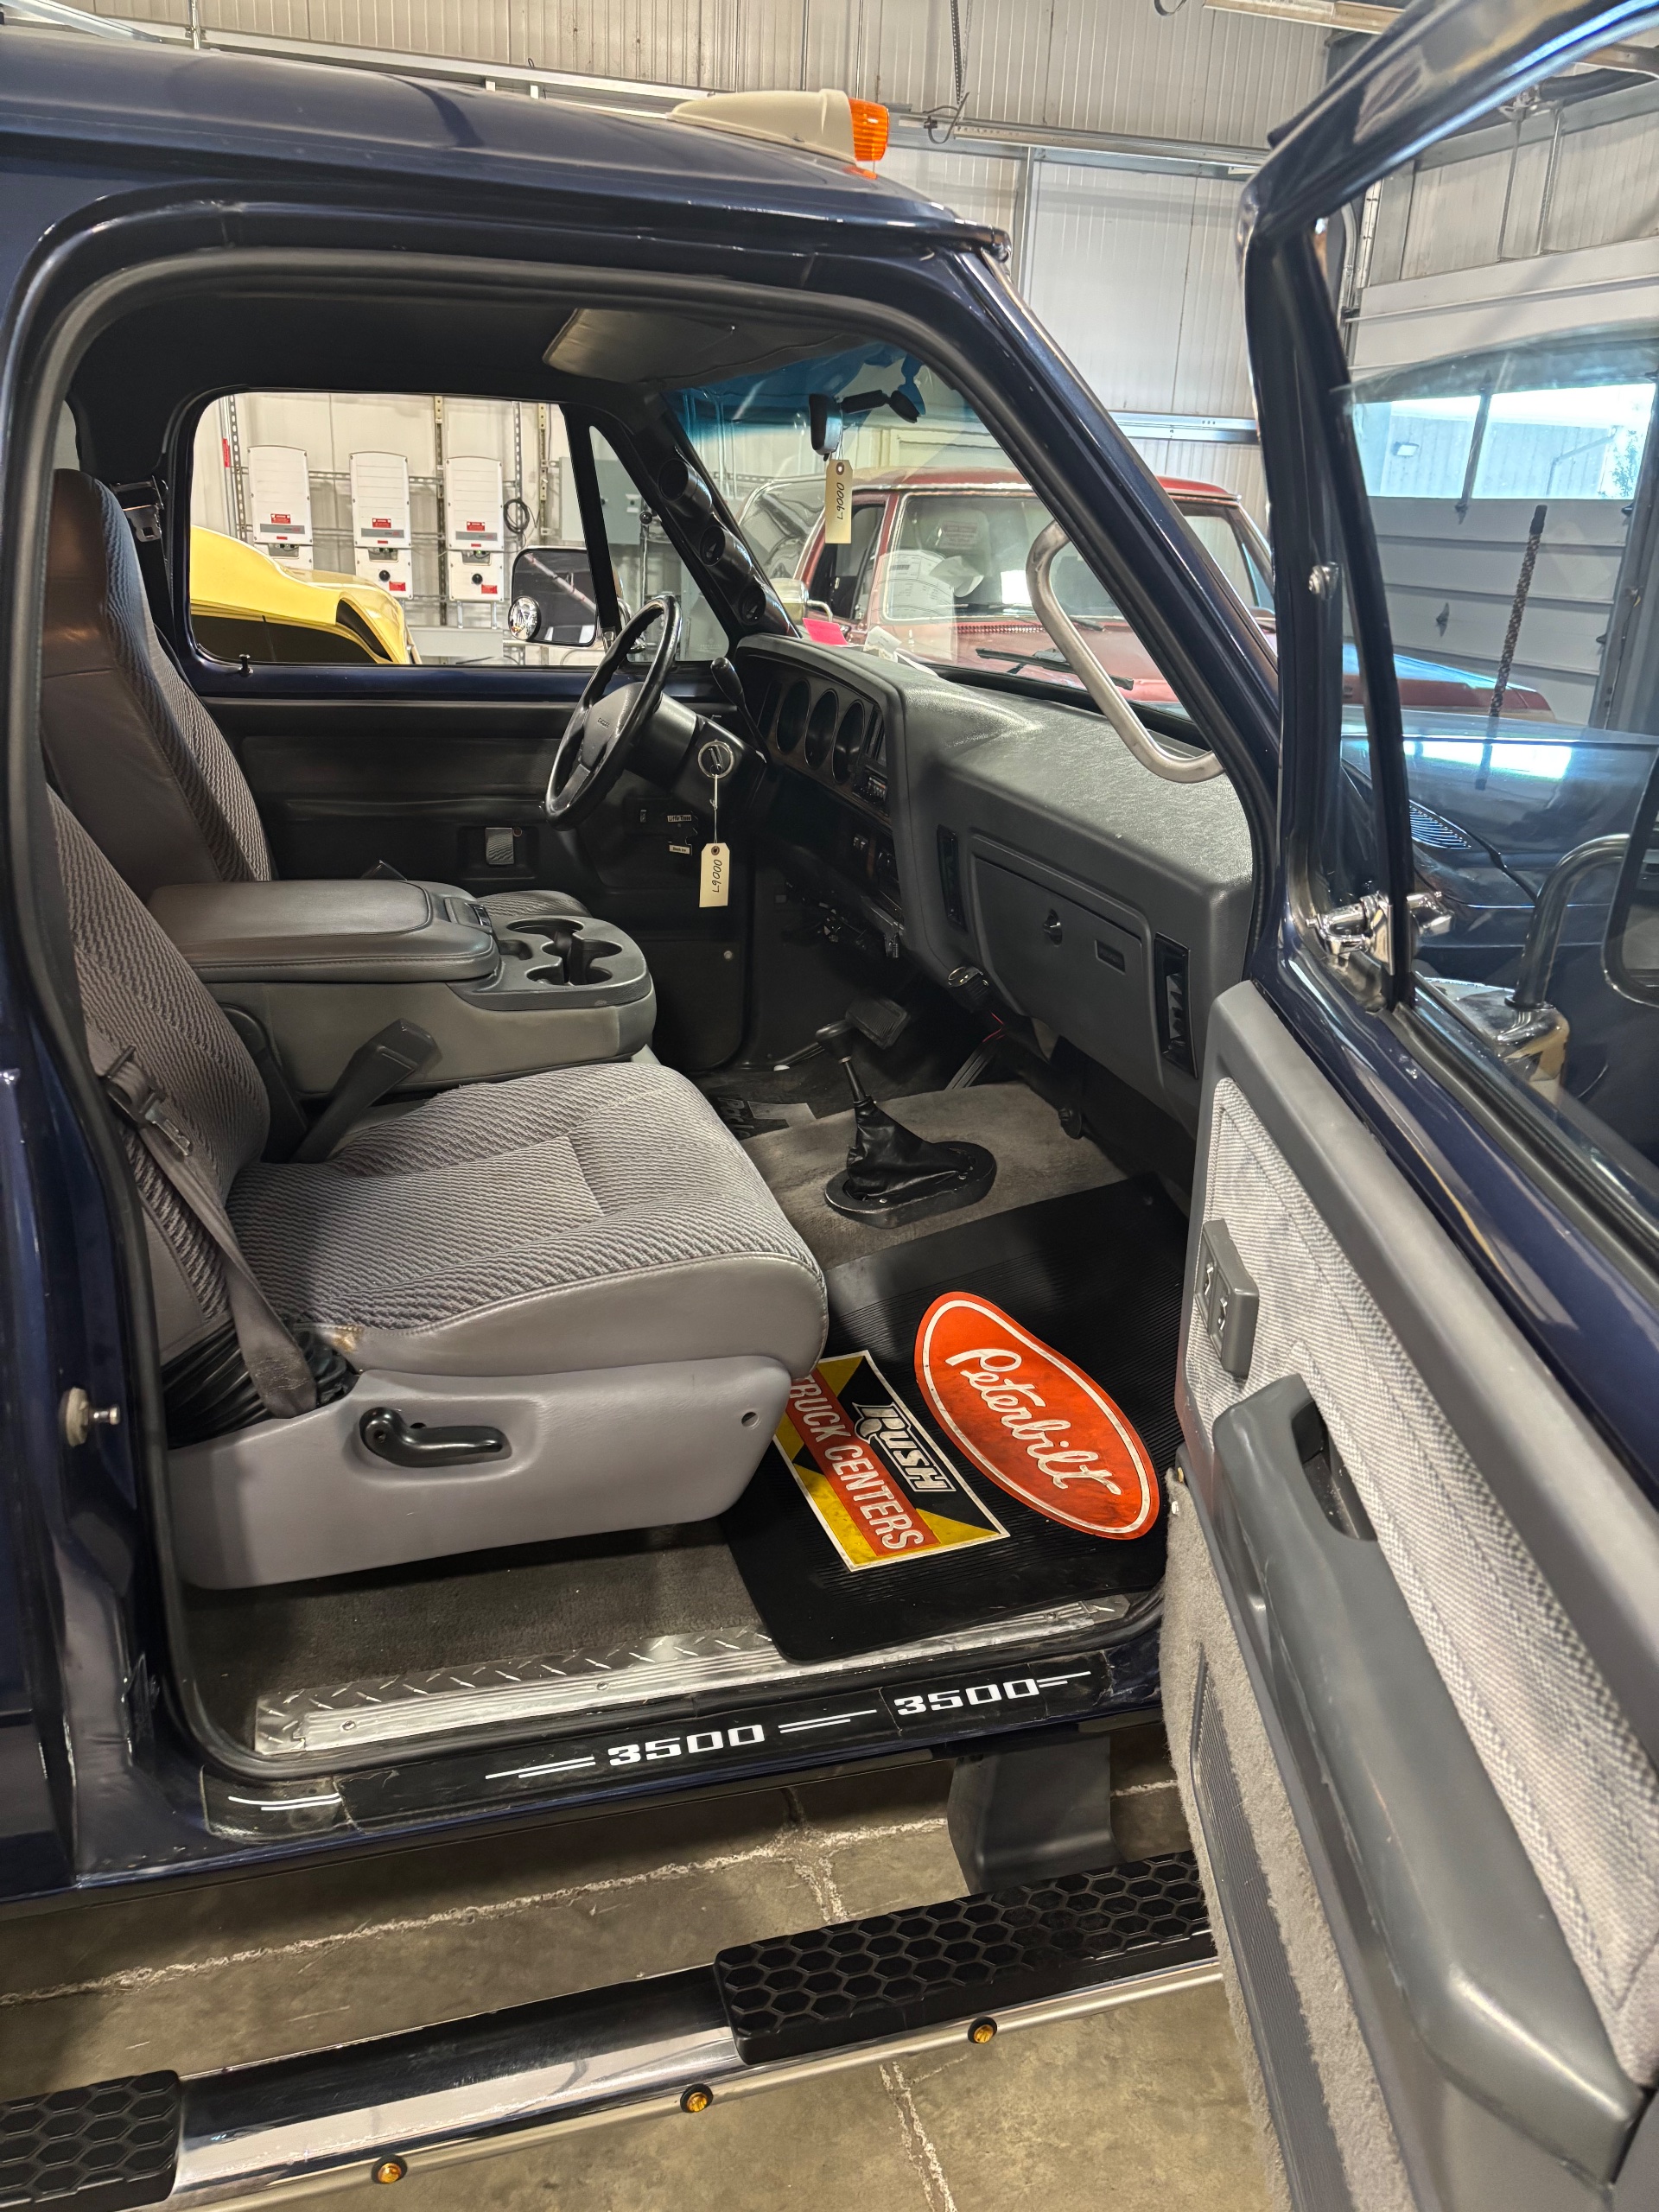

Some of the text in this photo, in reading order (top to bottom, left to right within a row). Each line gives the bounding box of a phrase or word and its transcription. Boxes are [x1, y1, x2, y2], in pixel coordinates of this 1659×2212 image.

[836, 482, 845, 520] L9000
[712, 859, 722, 893] L9000
[945, 1348, 1122, 1495] Peterbilt
[824, 1445, 925, 1549] CENTERS
[894, 1678, 1039, 1715] 3500
[607, 1724, 766, 1766] 3500
